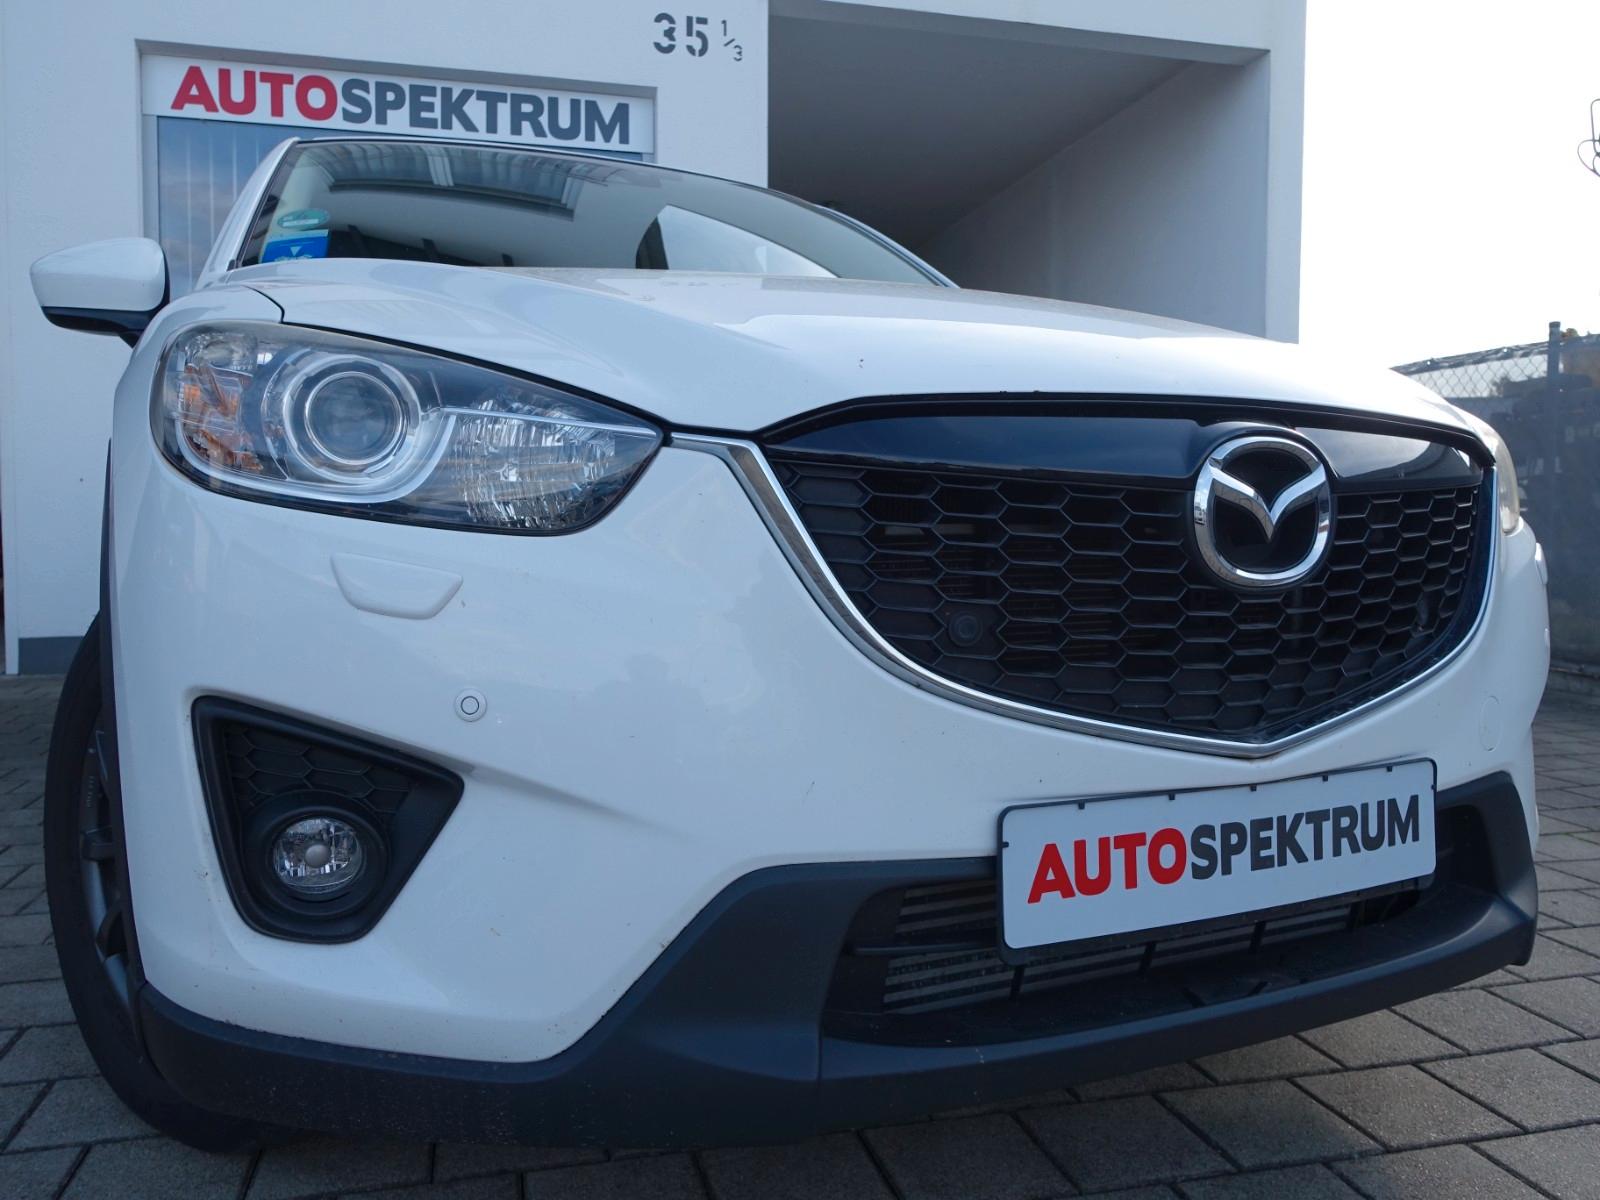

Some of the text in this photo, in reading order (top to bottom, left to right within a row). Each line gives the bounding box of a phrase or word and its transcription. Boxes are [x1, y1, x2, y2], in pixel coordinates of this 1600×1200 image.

[653, 12, 709, 57] 35
[171, 65, 630, 145] AUTOSPEKTRUM
[1027, 794, 1419, 904] AUTOSPEKTRUM
